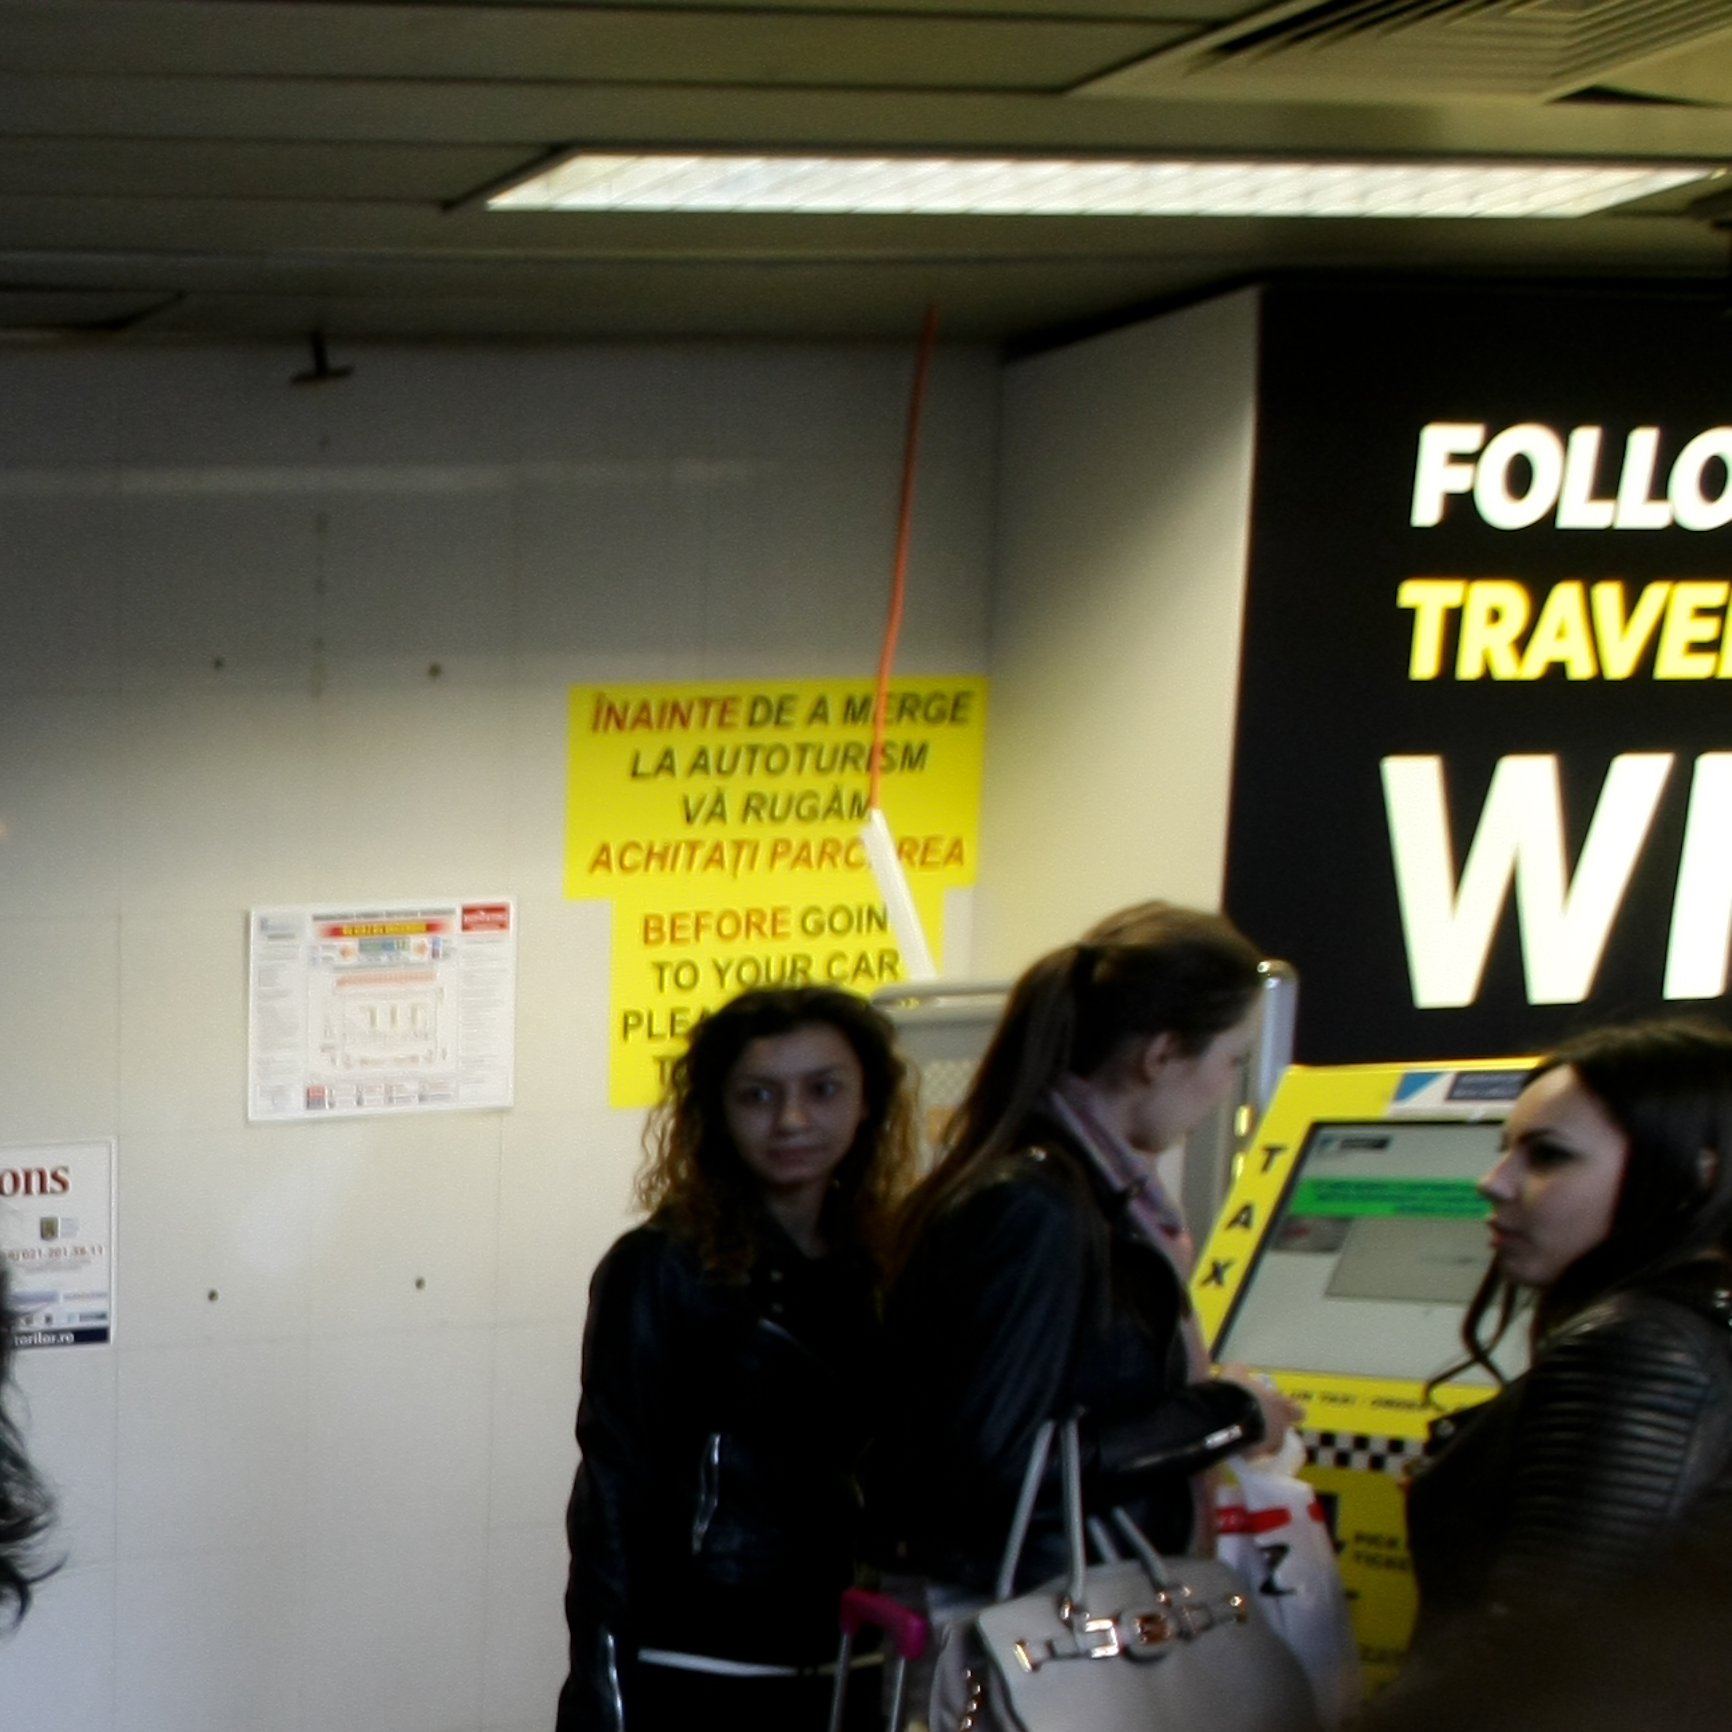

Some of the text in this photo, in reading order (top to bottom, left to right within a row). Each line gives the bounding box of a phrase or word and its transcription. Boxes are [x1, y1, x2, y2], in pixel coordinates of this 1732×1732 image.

[1397, 578, 1732, 681] TRAVE
[591, 692, 739, 733] ÎNAINTE
[748, 694, 799, 727] DE
[807, 694, 831, 726] A
[630, 748, 677, 779] LA
[681, 786, 729, 825] VĂ
[768, 834, 966, 871] PARCREA
[642, 904, 889, 946] BEFORE GOIN
[650, 948, 900, 993] TO YOUR CAR
